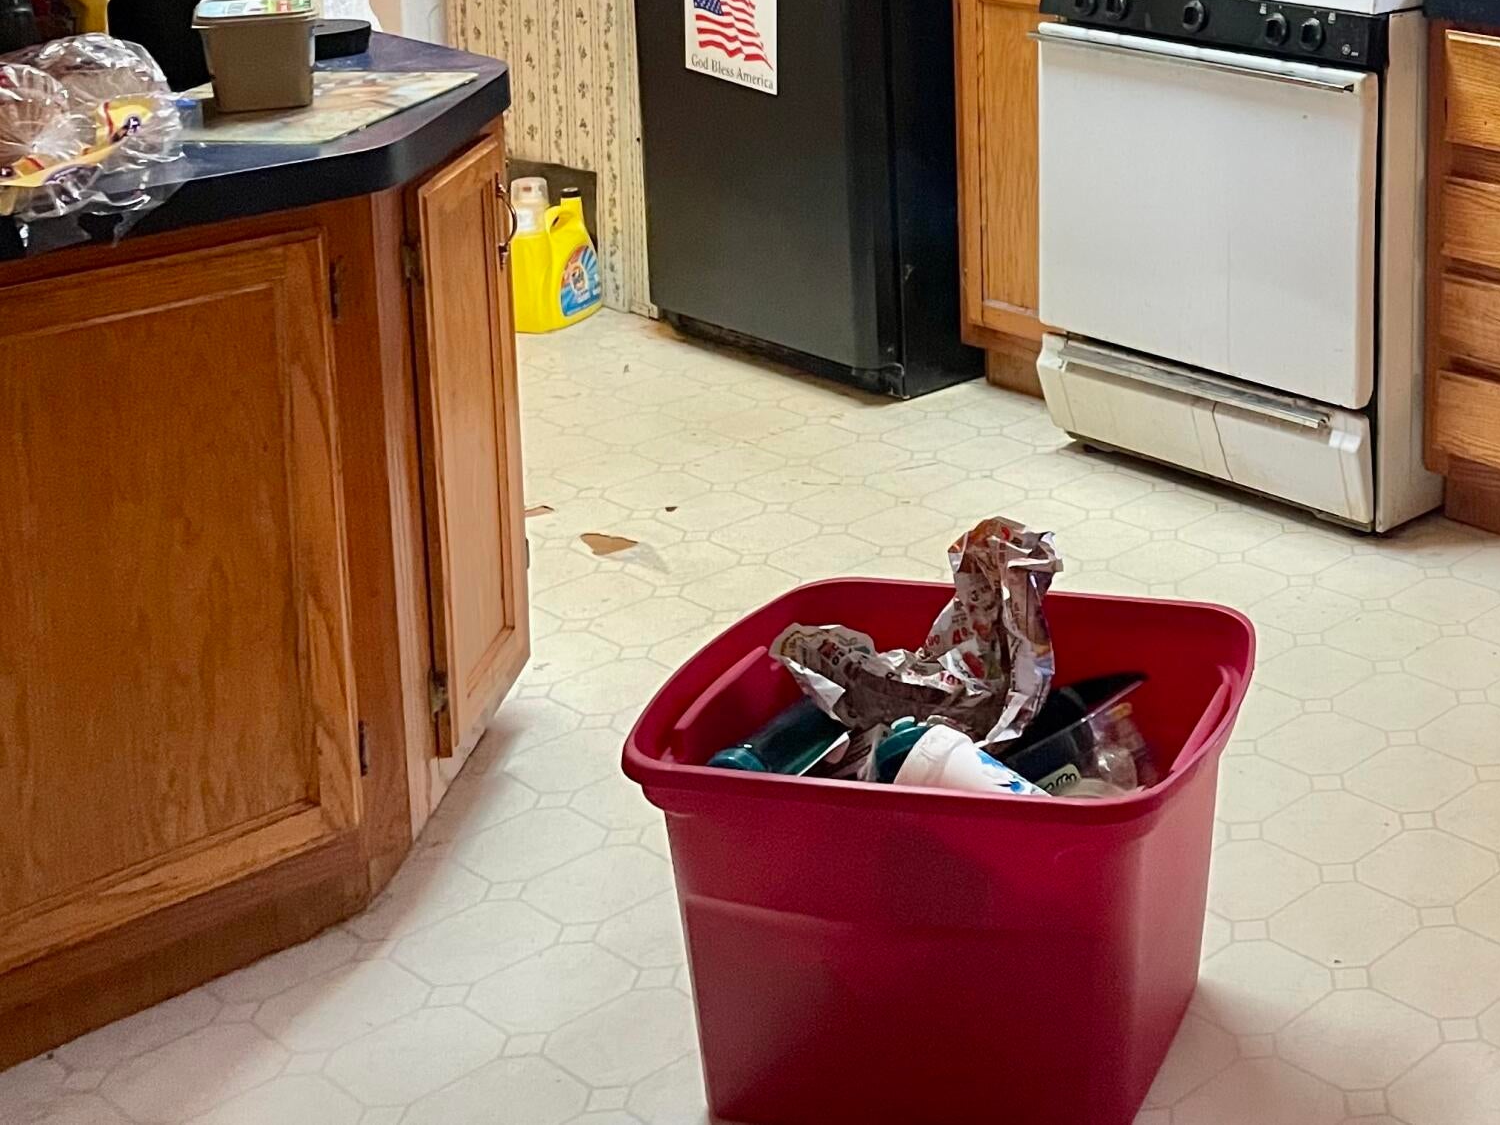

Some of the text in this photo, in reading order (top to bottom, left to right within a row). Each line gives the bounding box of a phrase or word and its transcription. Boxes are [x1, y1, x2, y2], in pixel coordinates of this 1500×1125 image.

[691, 53, 774, 90] God Bless America
